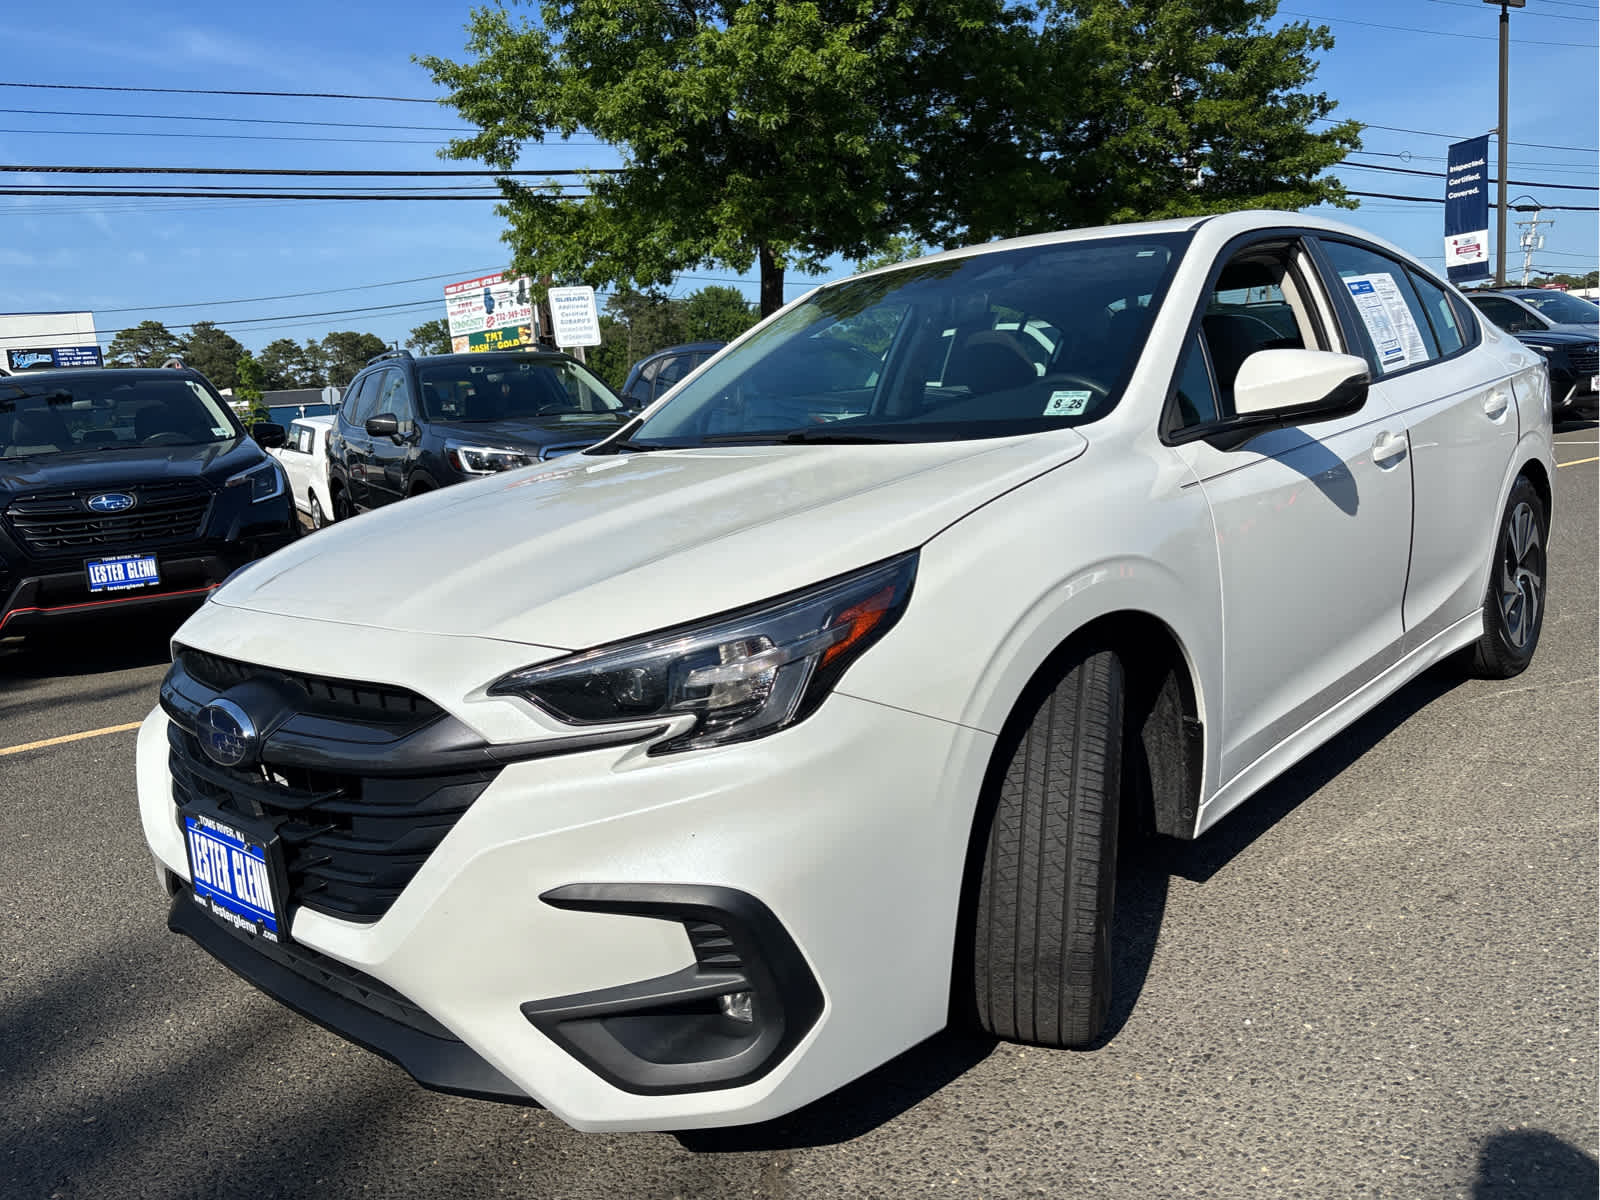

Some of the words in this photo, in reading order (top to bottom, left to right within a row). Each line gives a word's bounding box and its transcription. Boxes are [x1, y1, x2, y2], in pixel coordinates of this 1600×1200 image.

[1450, 158, 1485, 173] Inspected.
[1449, 172, 1480, 186] Certified.
[1448, 186, 1480, 199] Covered.
[484, 331, 504, 342] TMT
[470, 343, 490, 352] CASH
[497, 338, 520, 349] GOLD
[89, 564, 126, 584] LESTER
[126, 559, 157, 579] GLENN
[188, 830, 232, 894] LESTER
[231, 848, 275, 914] GLENN
[211, 900, 257, 935] lesterglenn
